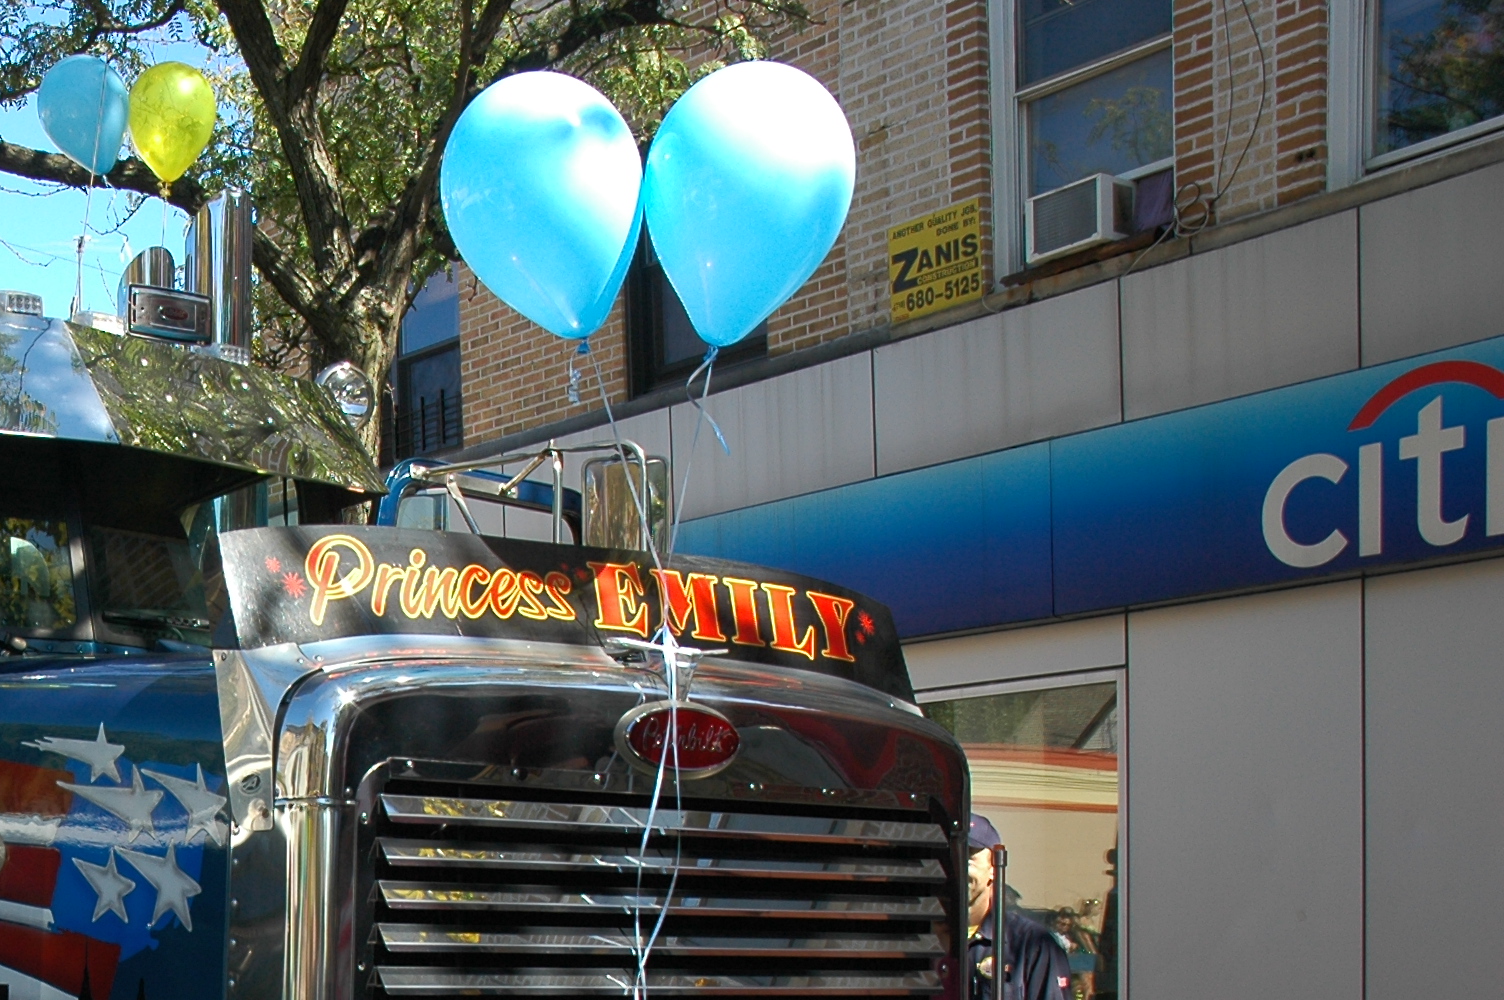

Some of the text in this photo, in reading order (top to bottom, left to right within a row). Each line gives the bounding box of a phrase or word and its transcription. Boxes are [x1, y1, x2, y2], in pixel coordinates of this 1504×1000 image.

[936, 222, 959, 236] DONE
[891, 233, 978, 294] ZANIS
[917, 260, 976, 286] CONSTRUCTION
[906, 272, 980, 312] 680-5125
[303, 533, 858, 663] Princess EMILY
